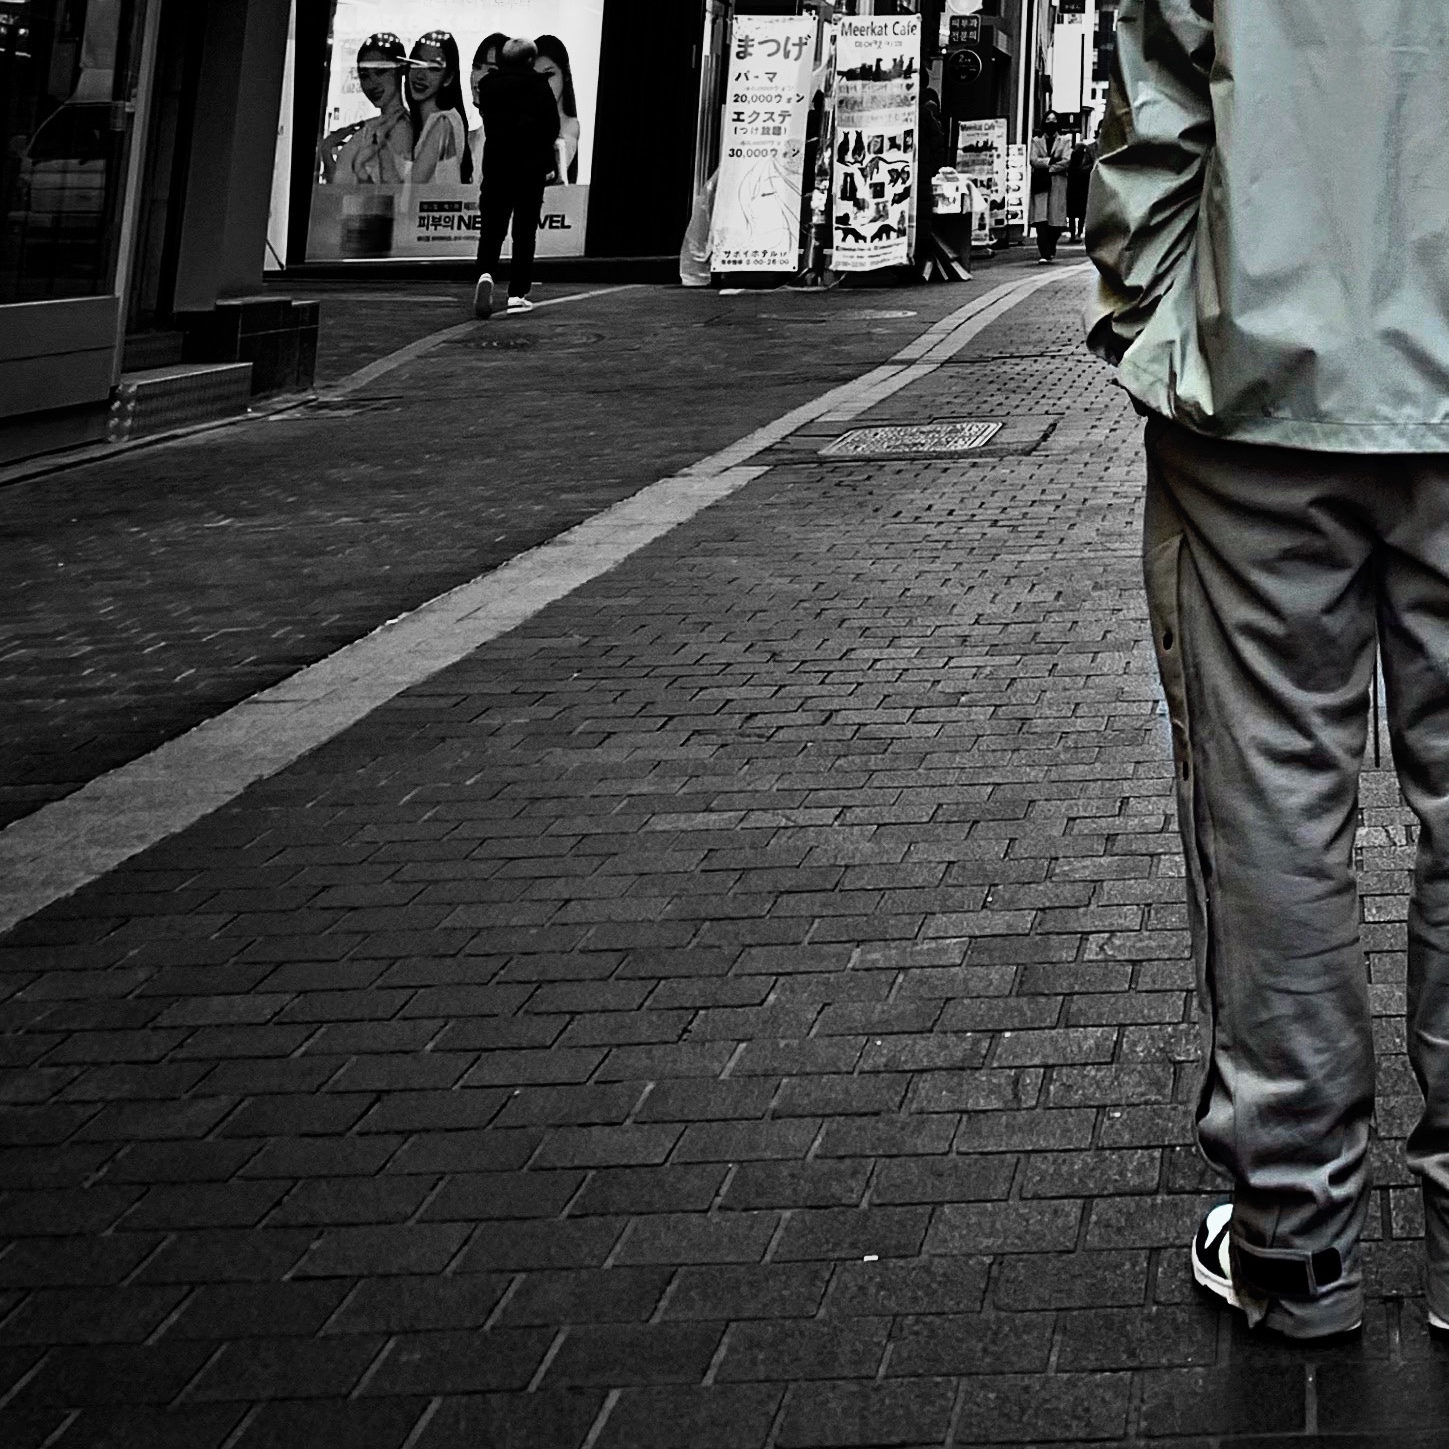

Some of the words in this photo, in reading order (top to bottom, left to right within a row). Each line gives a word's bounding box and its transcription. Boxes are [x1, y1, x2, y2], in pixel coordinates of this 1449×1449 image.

[841, 21, 889, 37] Meerkat
[892, 20, 918, 36] Cafe
[736, 34, 812, 62] まつげ
[731, 110, 792, 125] エクステ
[417, 215, 455, 231] 피부의
